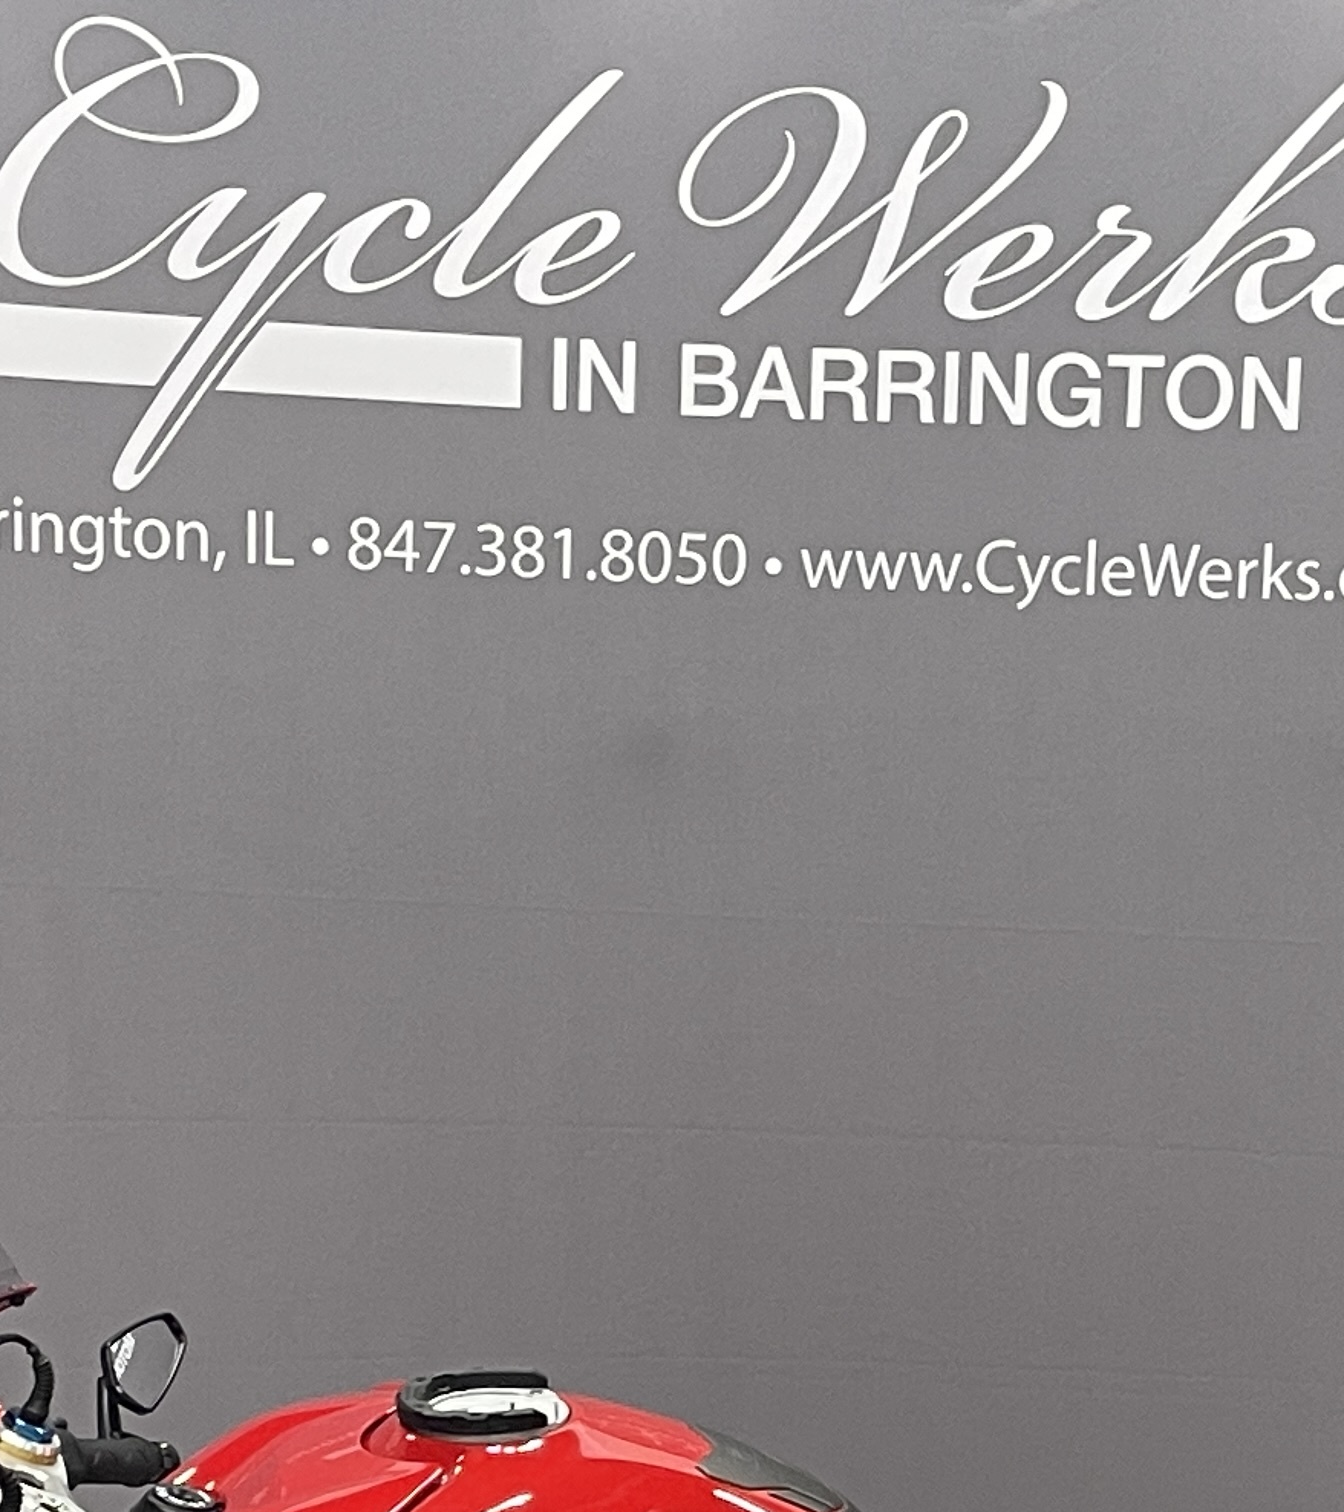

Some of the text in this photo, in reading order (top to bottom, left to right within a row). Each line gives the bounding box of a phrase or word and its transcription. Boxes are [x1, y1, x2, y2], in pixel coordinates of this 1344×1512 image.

[553, 337, 1302, 431] IN BARRINGTON
[247, 509, 295, 566] IL
[348, 516, 747, 587] 847.381.8050
